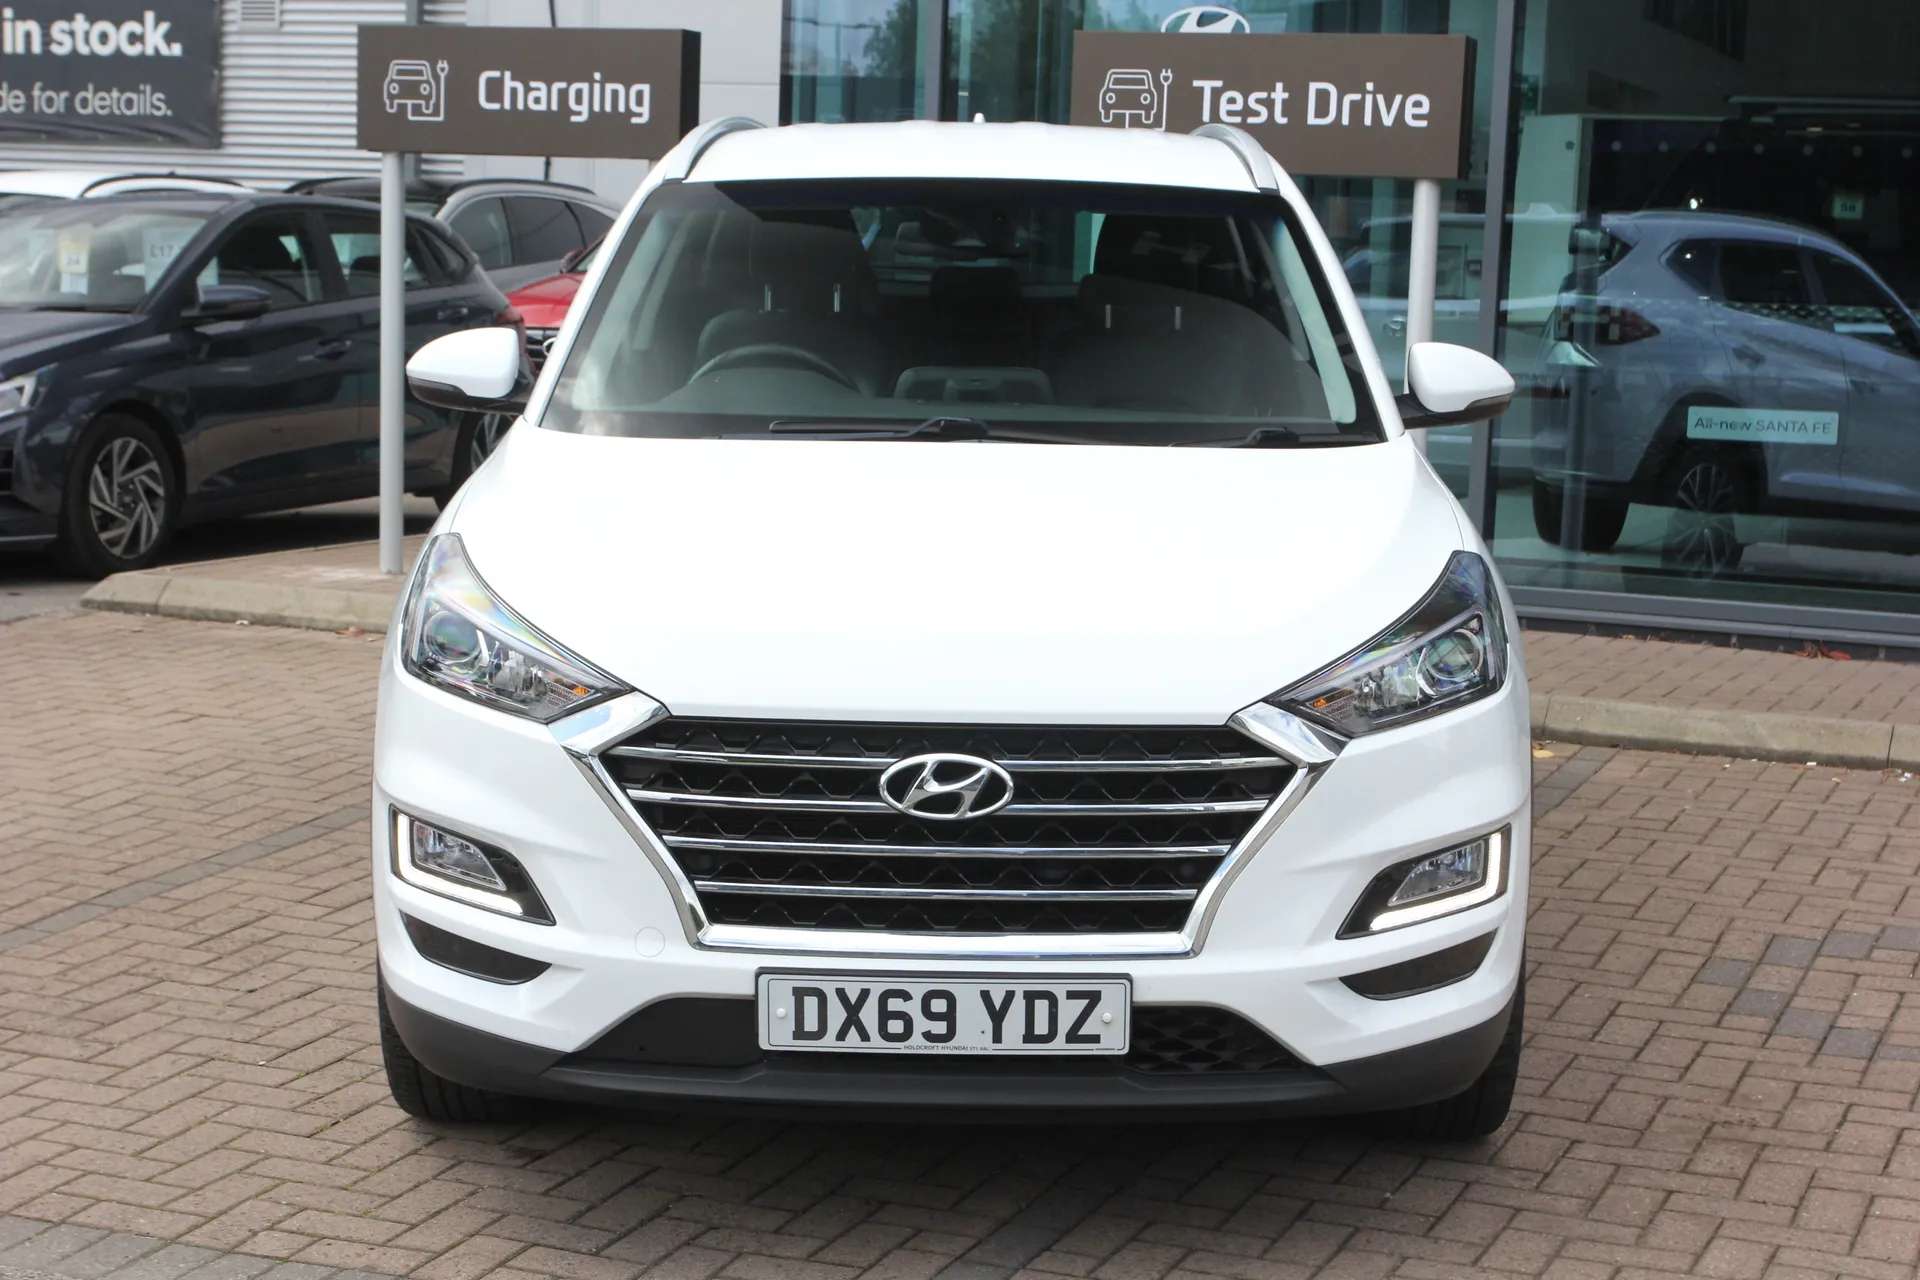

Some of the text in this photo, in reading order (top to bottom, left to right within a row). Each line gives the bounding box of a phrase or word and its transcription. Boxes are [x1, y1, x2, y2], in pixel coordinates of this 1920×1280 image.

[2, 7, 183, 57] in stock.
[32, 81, 70, 114] for
[74, 82, 173, 116] details.
[478, 70, 651, 124] Charging
[1192, 80, 1430, 128] Test Drive
[1694, 417, 1832, 434] All-new SANTA FE
[791, 986, 1102, 1045] DX69 YDZ
